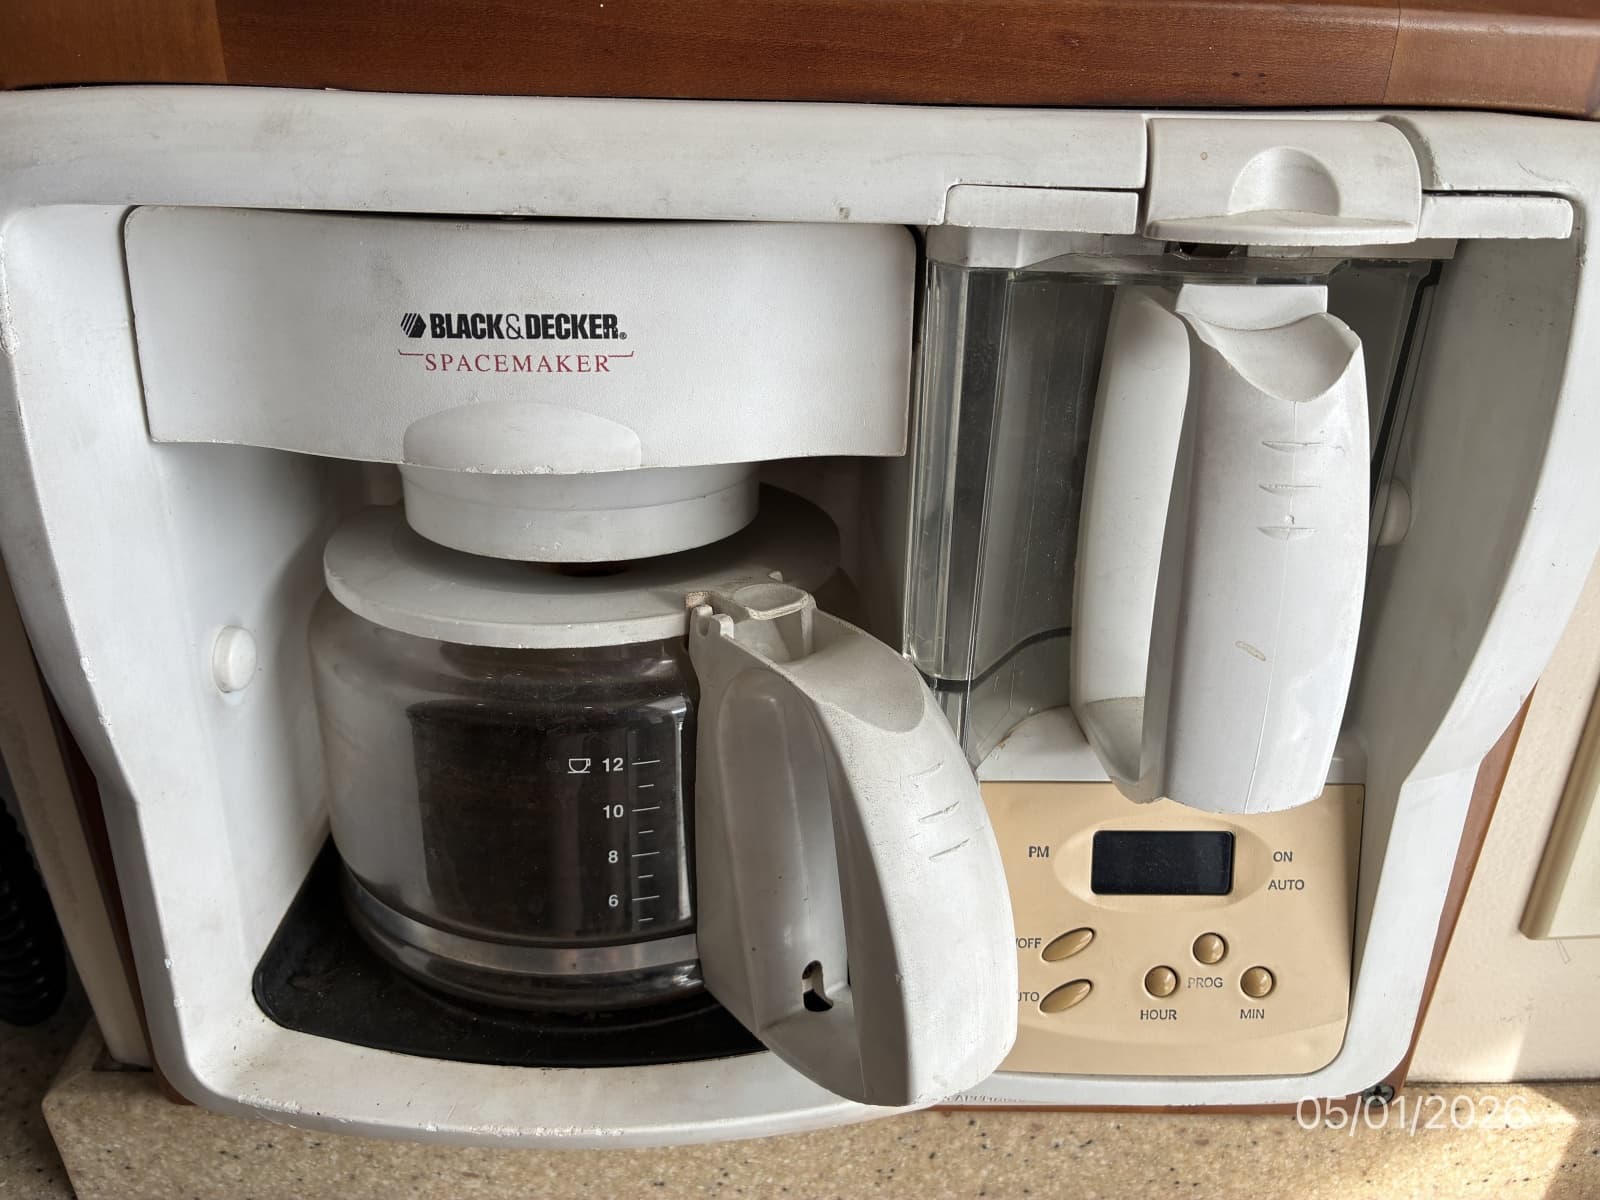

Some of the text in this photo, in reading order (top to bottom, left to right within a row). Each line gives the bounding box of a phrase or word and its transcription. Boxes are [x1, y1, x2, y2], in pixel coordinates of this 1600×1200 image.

[425, 353, 610, 373] SPACEMAKER
[602, 757, 624, 772] 12
[603, 804, 624, 819] 10
[608, 850, 619, 864] 8
[1028, 846, 1050, 858] PM
[1273, 851, 1293, 863] ON
[1268, 879, 1305, 891] AUTO
[608, 894, 619, 907] 6
[1187, 977, 1224, 989] PROG
[1140, 1009, 1177, 1021] HOUR
[1239, 1009, 1265, 1020] MIN
